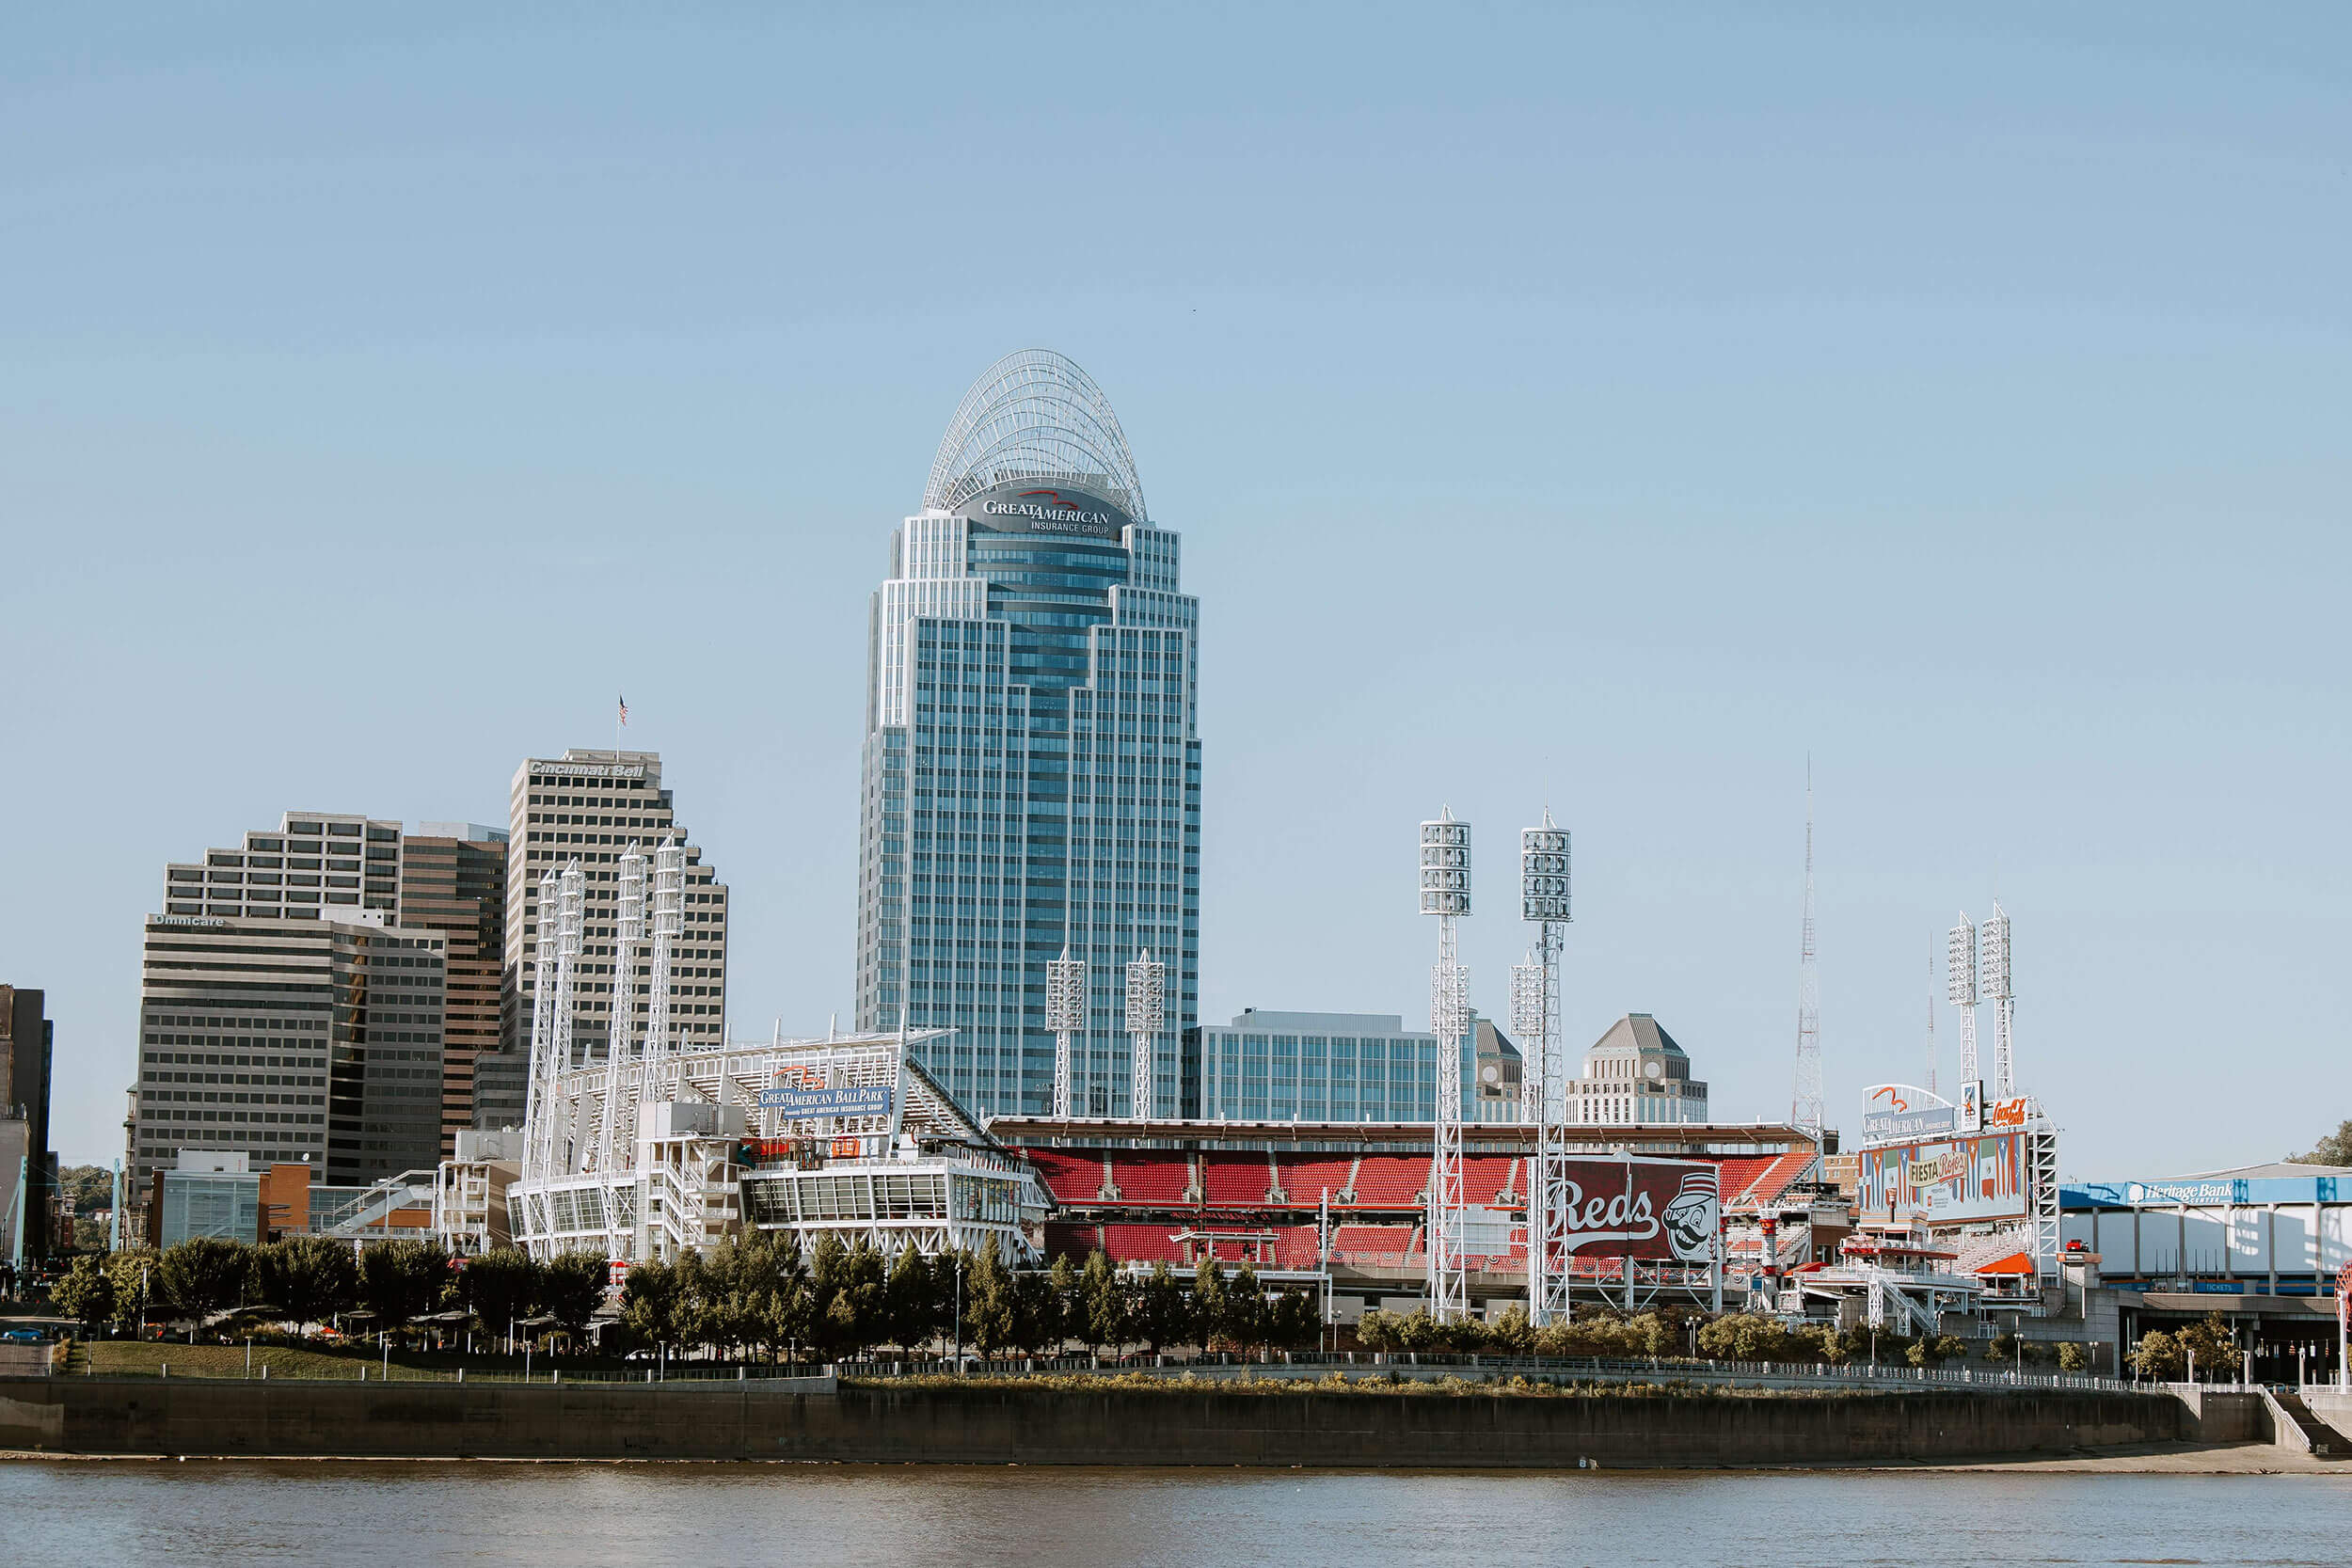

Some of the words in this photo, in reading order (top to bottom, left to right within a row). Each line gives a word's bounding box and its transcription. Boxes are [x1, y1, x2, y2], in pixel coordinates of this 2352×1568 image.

[1031, 521, 1079, 532] INSURANCE
[1082, 524, 1109, 535] GROUP
[531, 761, 609, 776] Cincinnati
[612, 765, 644, 777] Bell
[155, 914, 224, 927] Omnicare
[1911, 1162, 1938, 1182] FIESTA
[1938, 1152, 1965, 1183] Rojos
[2146, 1184, 2199, 1200] Heritage
[2199, 1183, 2233, 1197] Bank
[1546, 1181, 1661, 1252] Reds
